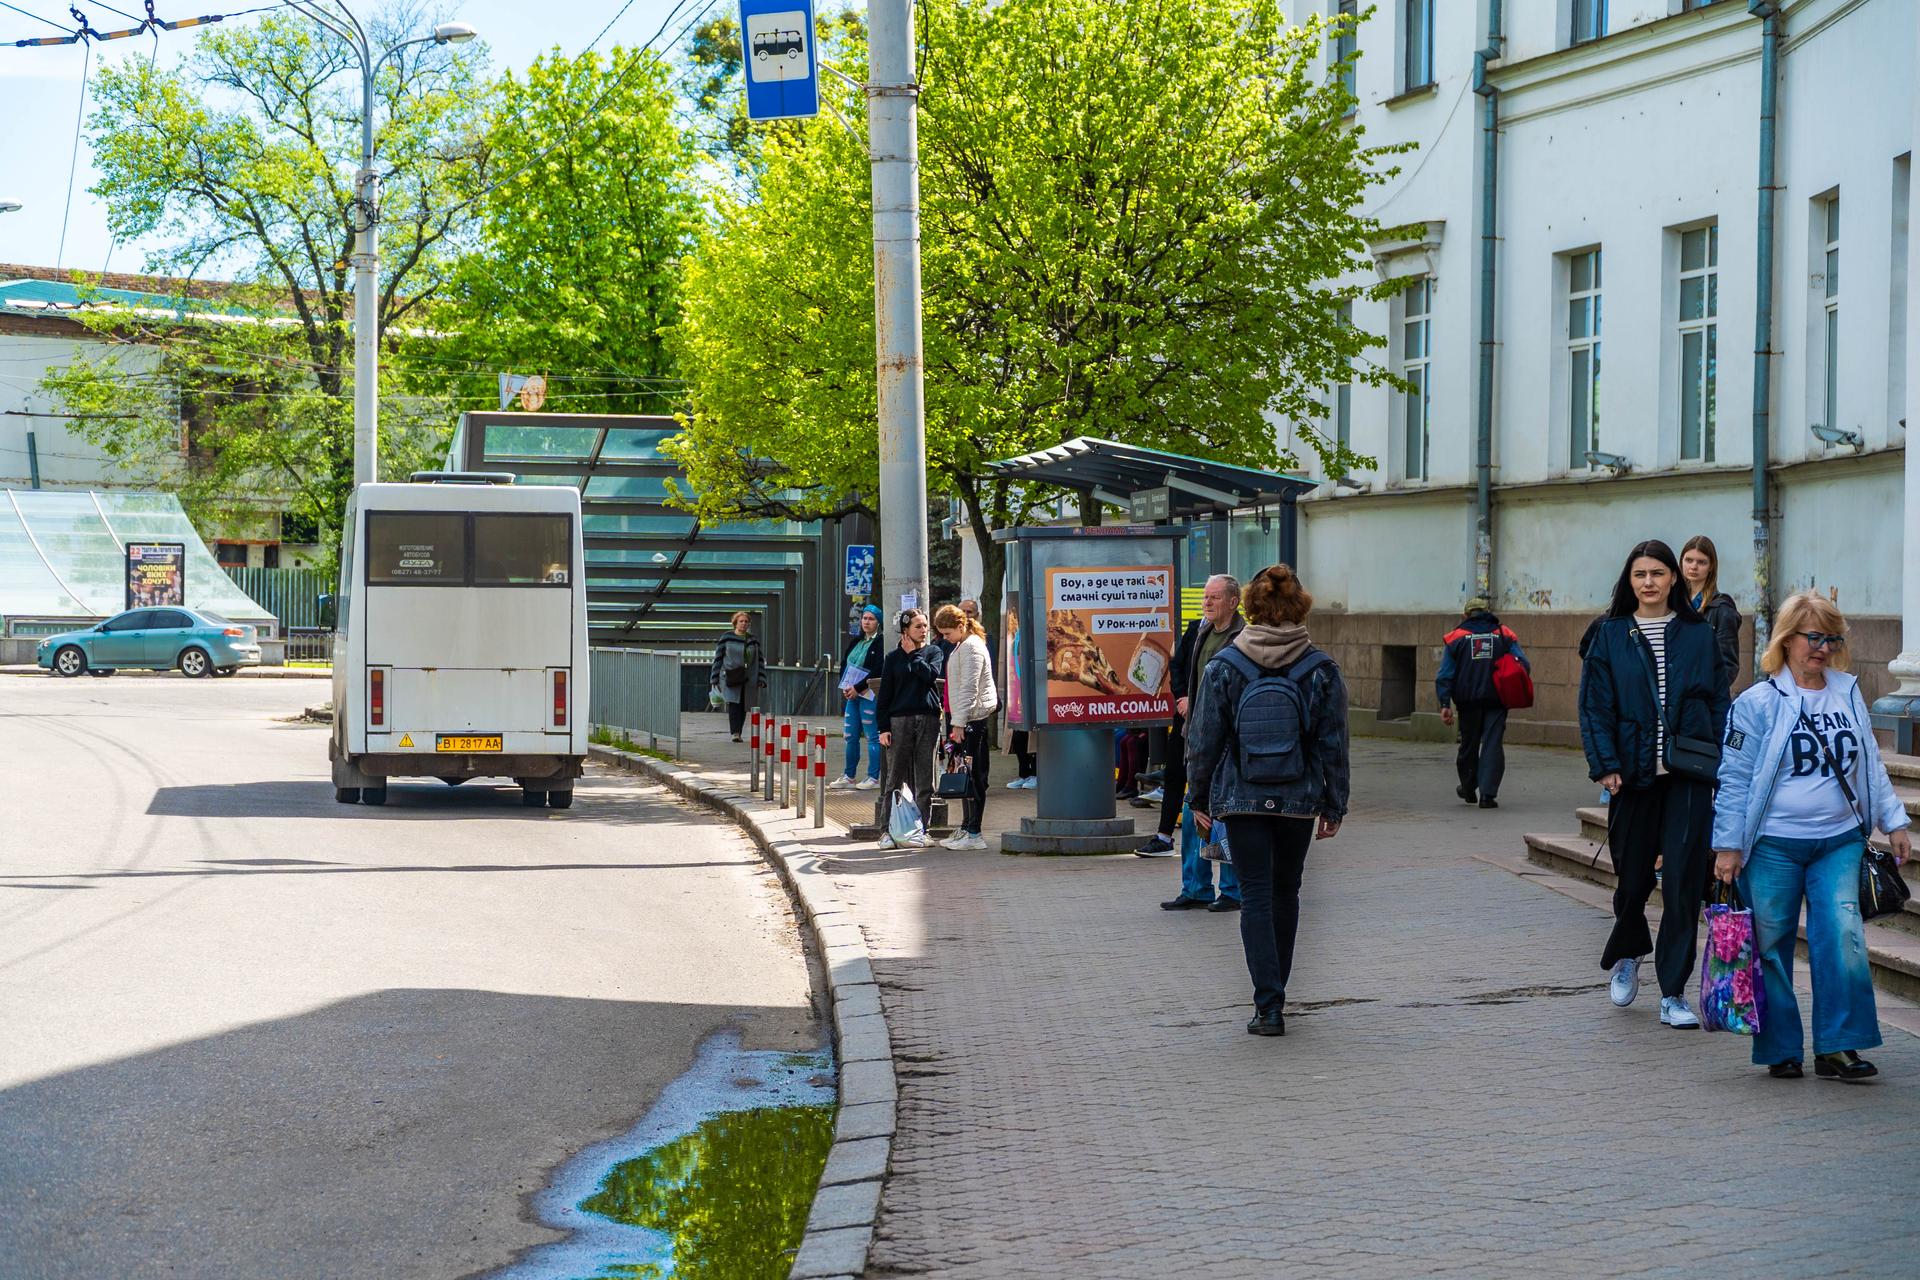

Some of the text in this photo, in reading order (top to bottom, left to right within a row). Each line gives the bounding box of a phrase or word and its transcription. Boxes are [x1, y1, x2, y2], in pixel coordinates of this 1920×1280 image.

[1061, 578, 1085, 589] Воу,
[1087, 579, 1094, 587] а
[1111, 578, 1124, 588] це
[1126, 575, 1146, 586] такі
[1061, 589, 1164, 603] смачні суші та піца?
[1107, 618, 1159, 630] Рок-н-рол!
[1088, 700, 1169, 715] RNR.COM.UA
[460, 738, 483, 749] 2817
[485, 738, 499, 749] AA
[1790, 730, 1859, 778] BIG
